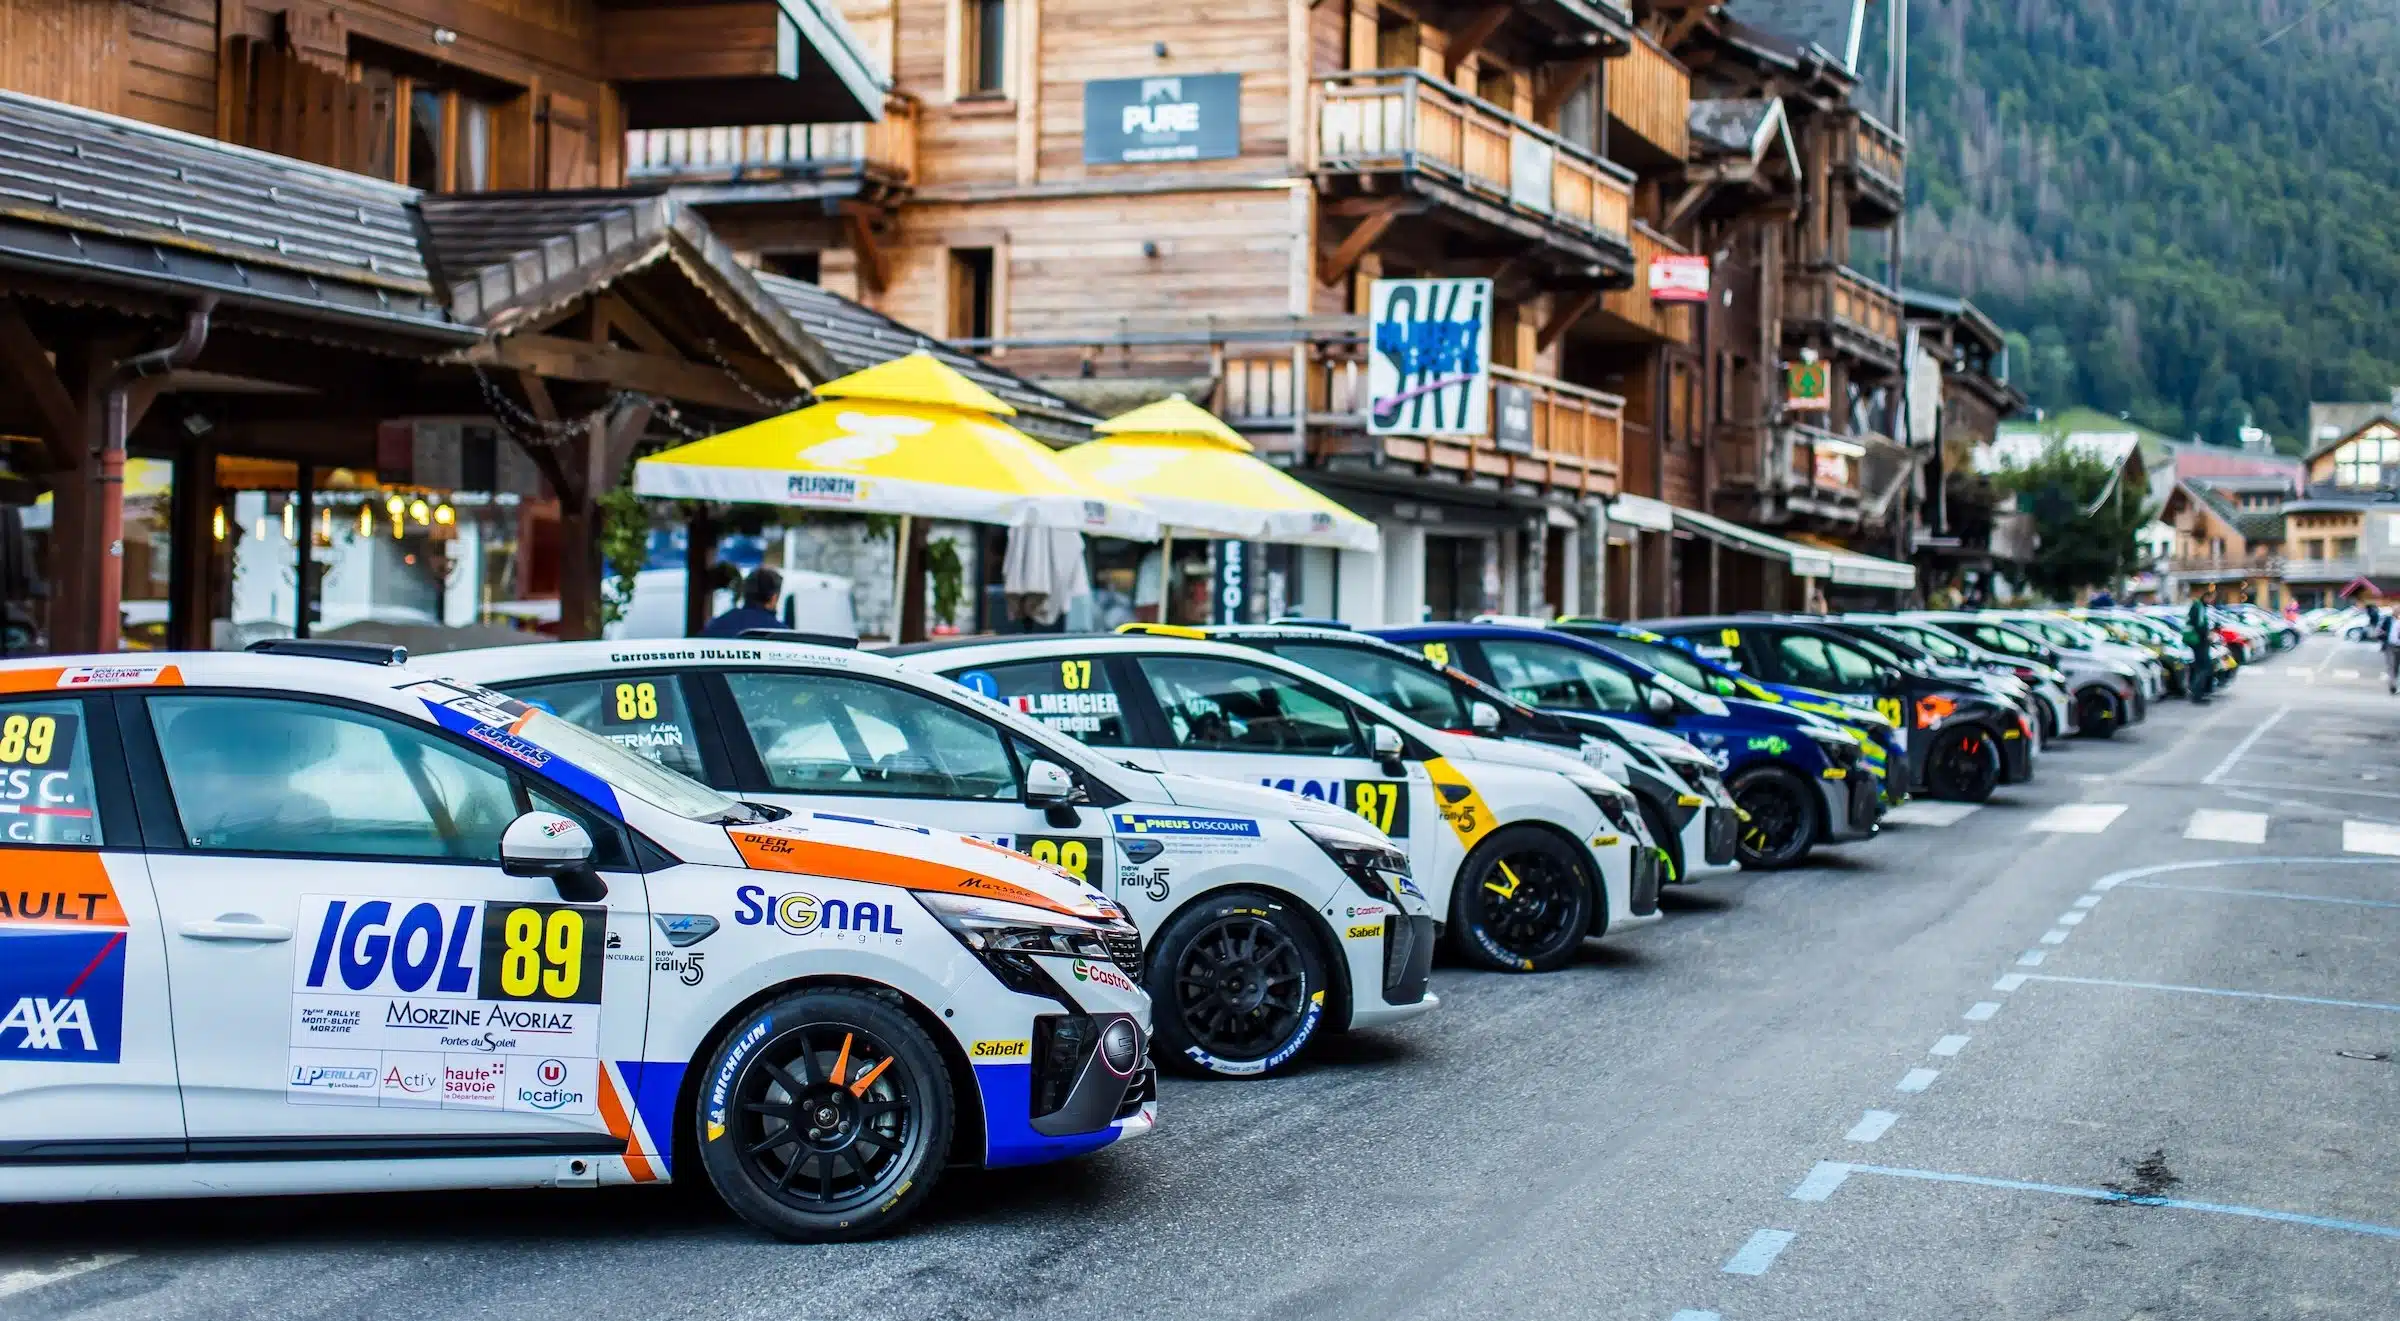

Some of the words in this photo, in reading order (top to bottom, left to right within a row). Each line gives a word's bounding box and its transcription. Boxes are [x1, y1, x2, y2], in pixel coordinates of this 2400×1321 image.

[1122, 102, 1199, 134] PURE
[787, 475, 855, 495] PELFORTH
[611, 650, 695, 662] Carrosserie
[700, 649, 762, 661] JULLIEN
[1061, 660, 1091, 690] 87
[615, 682, 658, 720] 88
[1027, 693, 1121, 714] L.MERCIER
[0, 715, 56, 765] 89
[39, 771, 75, 803] C.
[1355, 782, 1398, 835] 87
[551, 820, 579, 833] Castro
[1146, 818, 1190, 830] PNEUS
[1192, 820, 1250, 833] DISCOUNT
[1348, 925, 1380, 938] Sabelt
[306, 900, 477, 993] IGOL
[501, 907, 584, 998] 89
[0, 997, 99, 1051] AXA
[301, 1017, 360, 1026] MONT-BLANC
[327, 1010, 361, 1018] RALLYE
[386, 1000, 481, 1026] MORZINE
[485, 1004, 573, 1030] AVORIAZ
[309, 1025, 352, 1033] MORZINE
[440, 1036, 469, 1047] Portes
[471, 1036, 483, 1047] du
[483, 1032, 516, 1052] Soleil
[974, 1041, 1025, 1056] Sabelt
[1269, 1014, 1318, 1065] MICHELIN
[445, 1066, 490, 1081] haute
[544, 1066, 560, 1081] U
[711, 1022, 767, 1105] MICHELIN
[445, 1081, 496, 1093] savoie
[452, 1093, 495, 1101] Département
[518, 1087, 583, 1103] location
